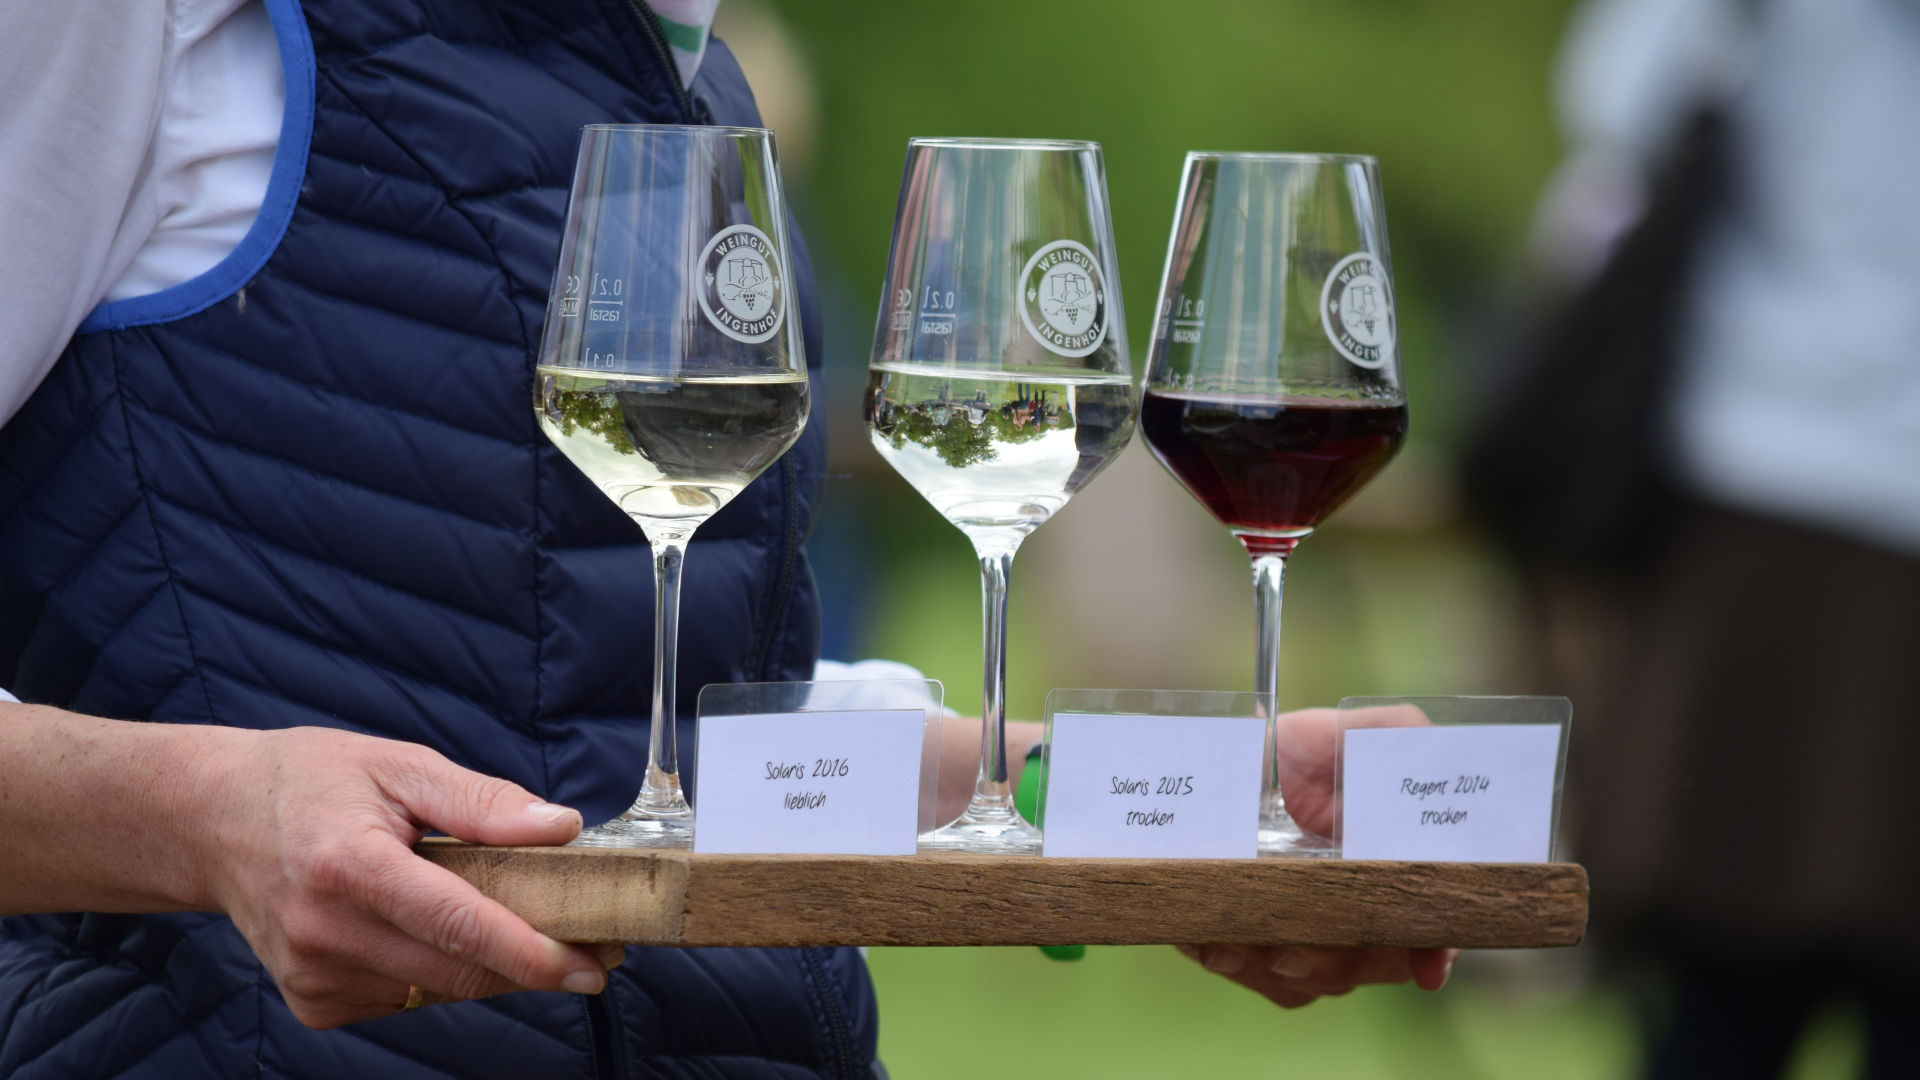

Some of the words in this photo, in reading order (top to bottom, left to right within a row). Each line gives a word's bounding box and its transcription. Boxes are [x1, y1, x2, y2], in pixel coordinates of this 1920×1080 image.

[715, 234, 771, 259] WEINGUT
[1037, 250, 1095, 275] WEINGUT
[1339, 260, 1377, 286] WEING
[715, 307, 778, 335] INGENHOF
[1038, 322, 1100, 349] INGENHOF
[1341, 333, 1380, 361] INGEN
[764, 761, 806, 780] Solaris
[812, 758, 849, 777] 2016
[1110, 776, 1150, 796] Solaris
[1156, 776, 1195, 796] 2015
[1401, 778, 1449, 801] Regent
[1454, 775, 1490, 794] 2014
[784, 791, 827, 810] lieblich
[1126, 808, 1175, 826] trocken
[1421, 806, 1468, 825] trocken
